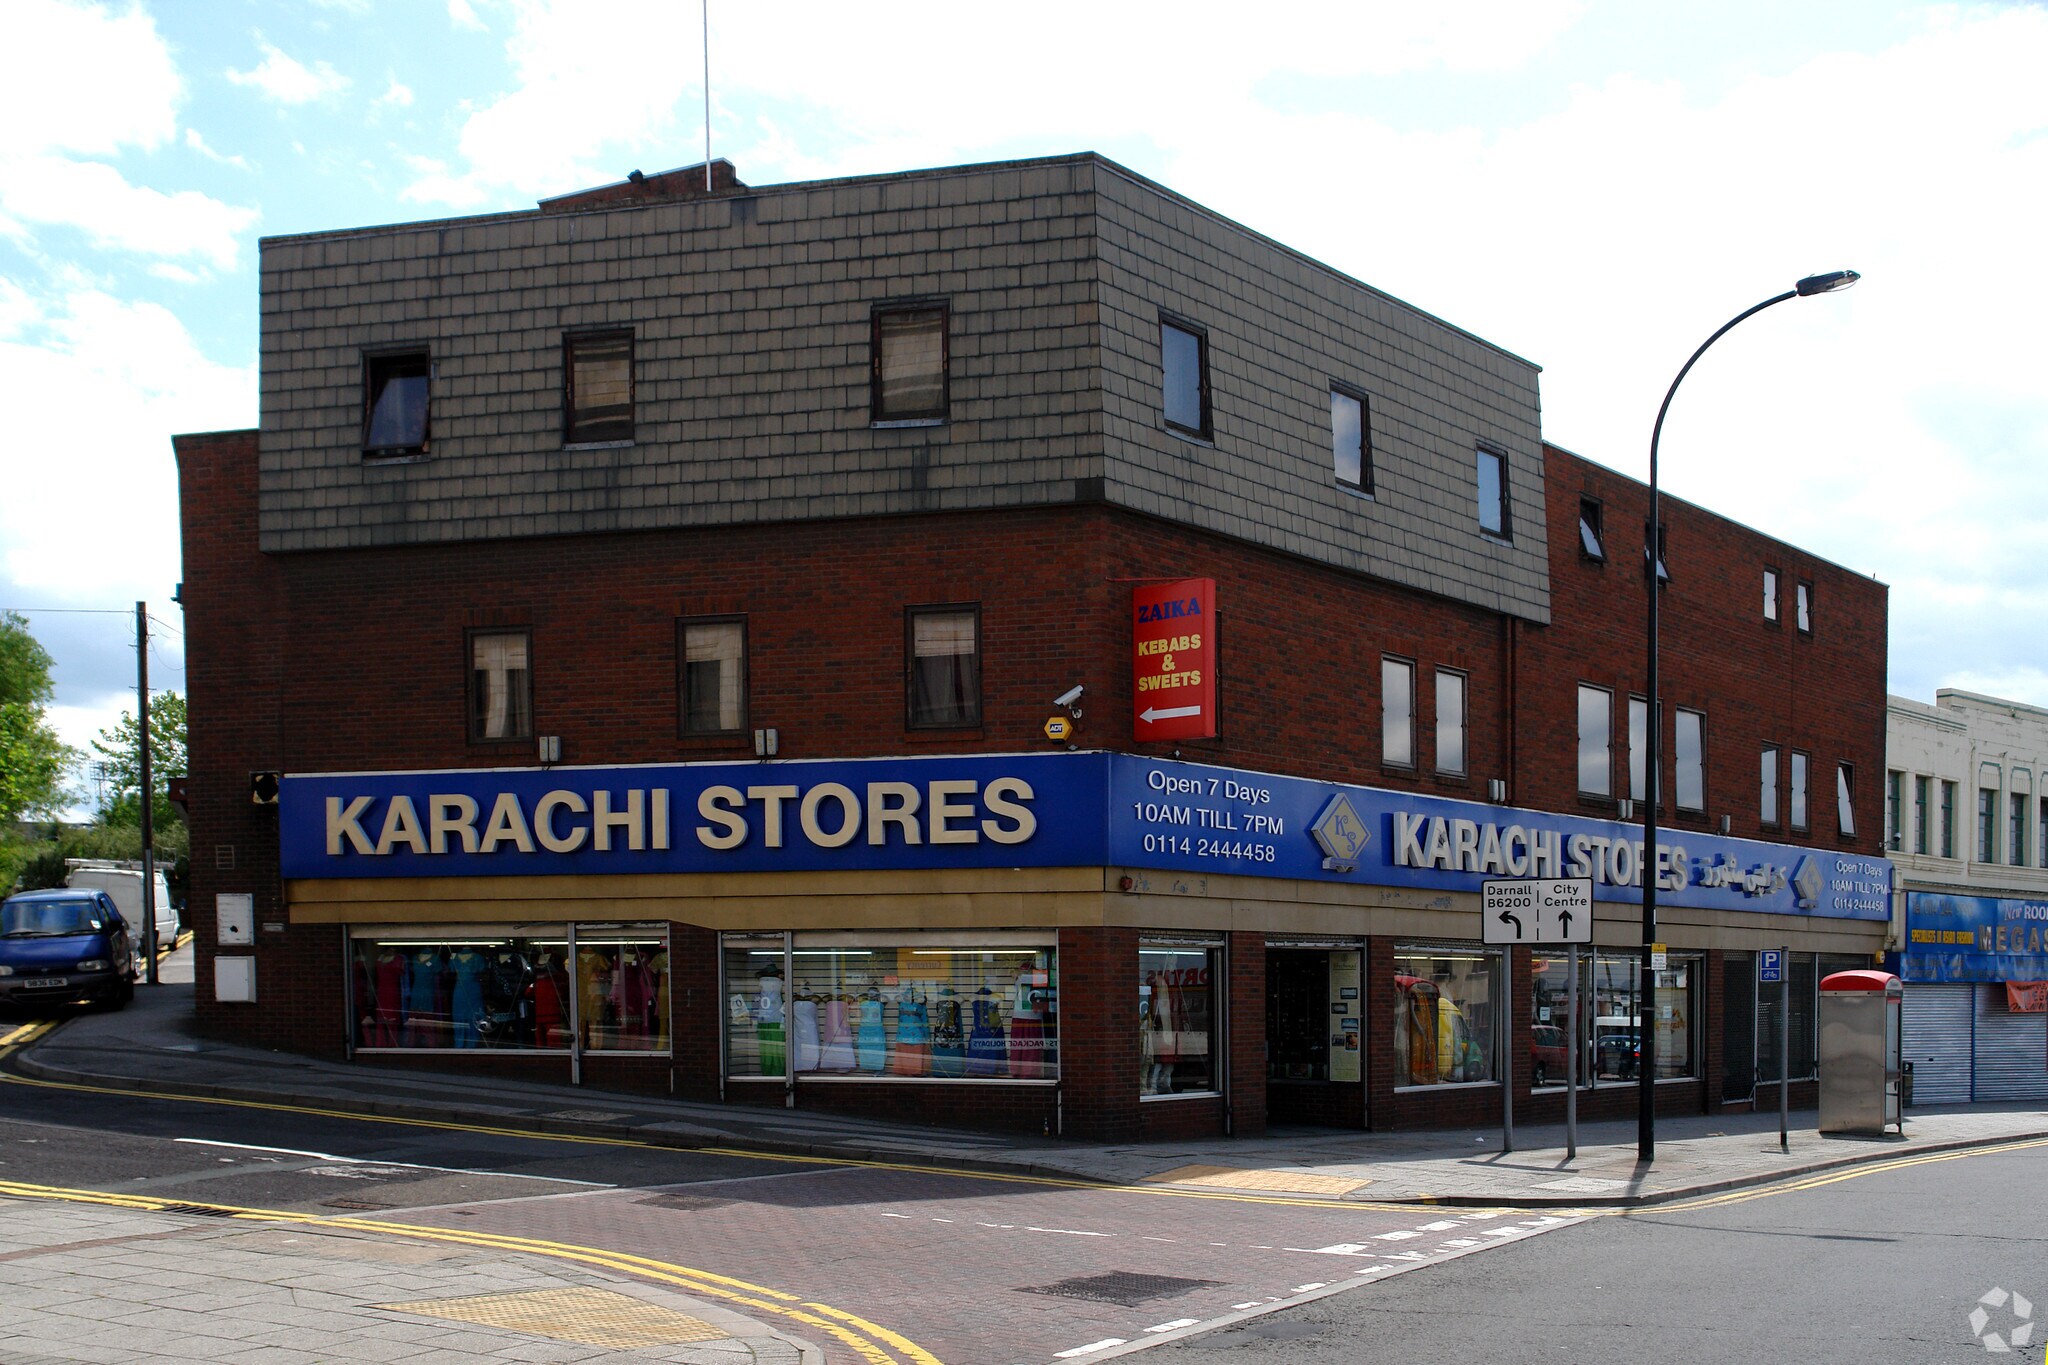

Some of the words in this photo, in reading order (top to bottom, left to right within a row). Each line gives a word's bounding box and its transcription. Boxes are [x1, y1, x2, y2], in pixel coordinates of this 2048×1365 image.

[1138, 597, 1201, 624] ZAIKA
[1138, 634, 1201, 656] KEBABS
[1162, 654, 1176, 672] &
[1138, 670, 1201, 692] SWEETS
[1148, 770, 1201, 795] Open
[1208, 779, 1219, 796] 7
[1226, 781, 1270, 805] Days
[326, 788, 670, 855] KARACHI
[696, 777, 1037, 850] STORES
[1134, 802, 1190, 825] 10AM
[1196, 808, 1237, 830] TILL
[1243, 814, 1283, 835] 7PM
[1144, 834, 1190, 854] 0114
[1198, 838, 1275, 862] 2444458
[1394, 812, 1561, 878] KARACHI
[1836, 860, 1857, 874] Open
[1864, 864, 1882, 878] Days
[1488, 885, 1532, 895] Darnall
[1553, 885, 1578, 897] City
[1832, 880, 1852, 892] 10AM
[1854, 882, 1870, 894] TILL
[1872, 884, 1888, 894] 7PM
[1488, 898, 1531, 908] B6200
[1544, 896, 1587, 907] Centre
[1834, 898, 1852, 909] 0114
[1854, 899, 1884, 912] 2444458
[2024, 905, 2048, 920] ROO
[1765, 953, 1776, 967] P
